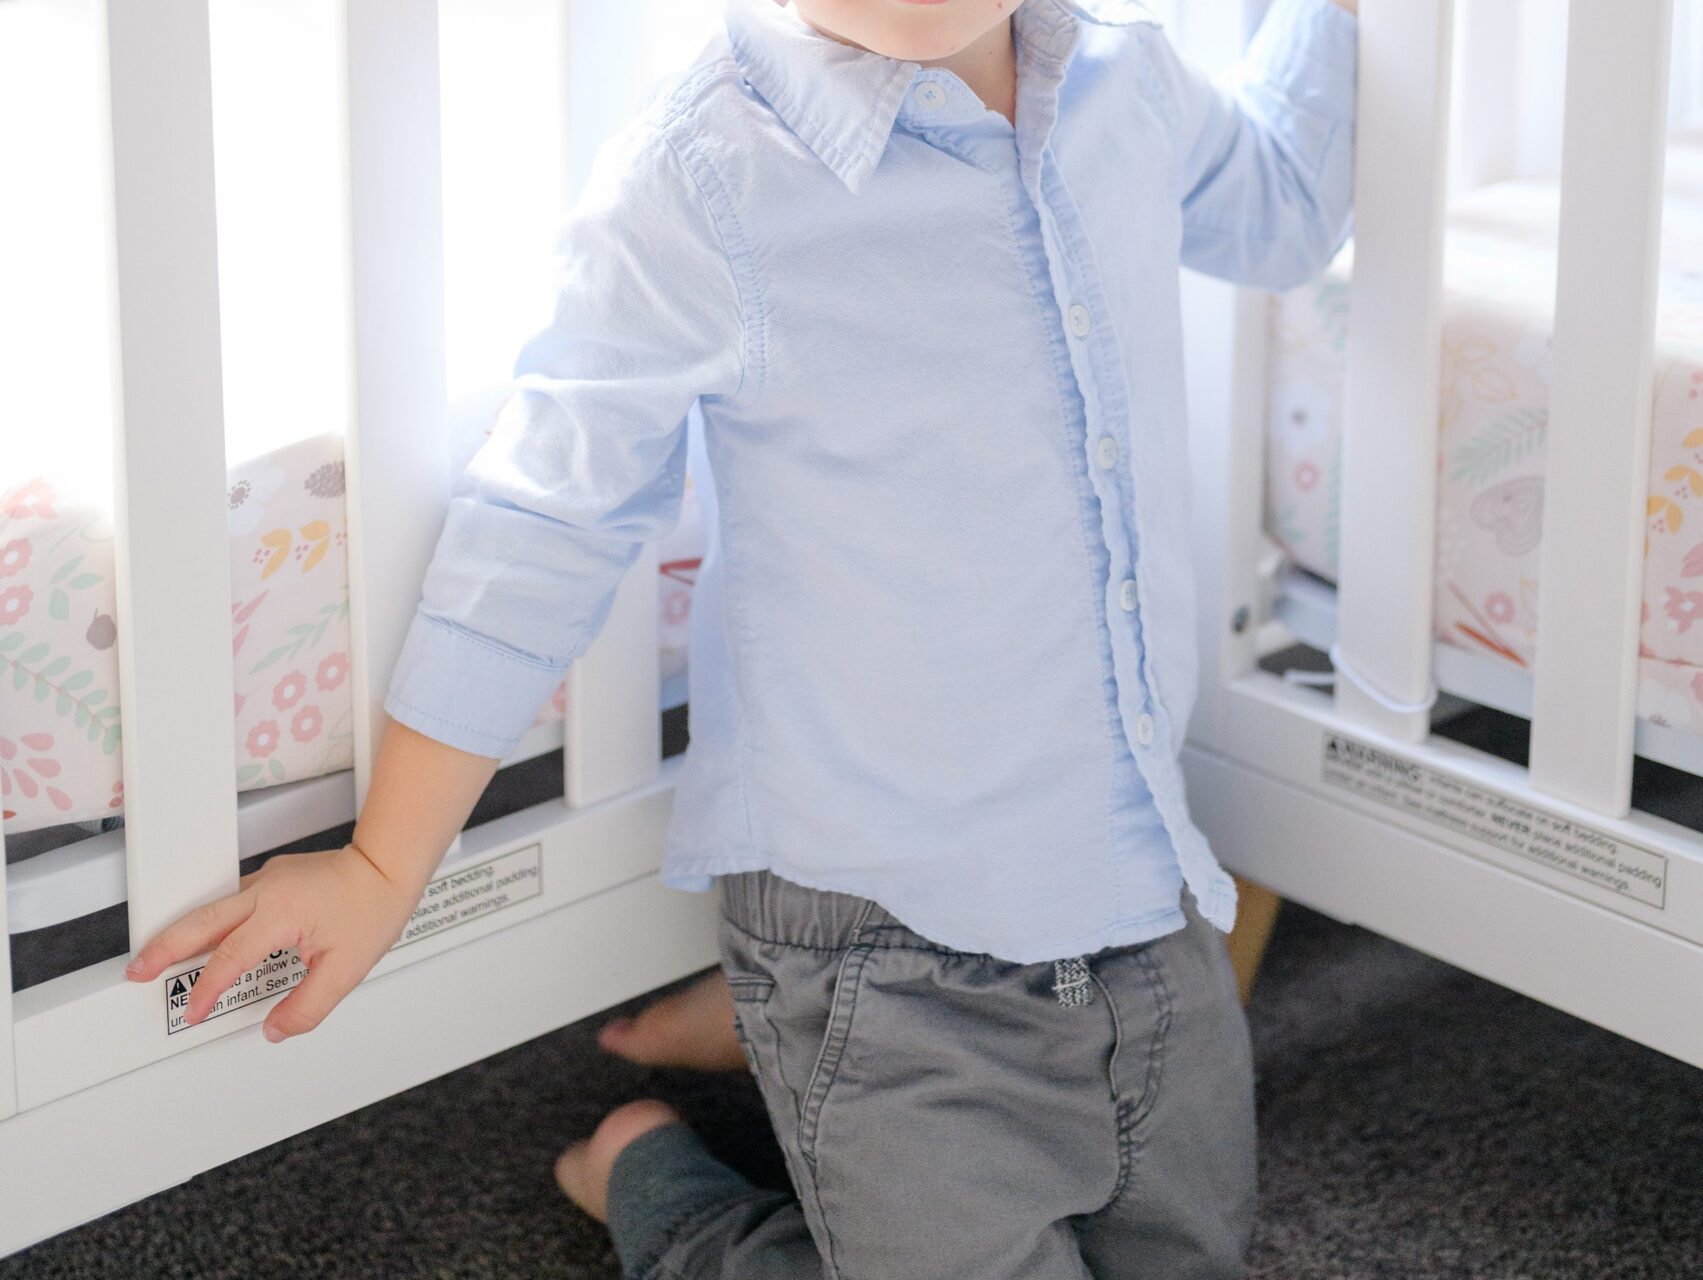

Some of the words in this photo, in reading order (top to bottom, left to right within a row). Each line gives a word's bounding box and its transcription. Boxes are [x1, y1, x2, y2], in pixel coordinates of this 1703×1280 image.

[1552, 820, 1571, 832] soft
[1491, 812, 1530, 834] NEVER
[1565, 842, 1616, 868] additional
[1618, 862, 1662, 889] padding
[1527, 844, 1577, 869] additional
[428, 881, 448, 897] soft
[442, 882, 493, 909] additional
[496, 865, 538, 891] padding
[405, 910, 457, 939] additional
[245, 972, 252, 982] a
[256, 959, 288, 981] pillow
[227, 986, 261, 1007] infant.
[266, 976, 289, 991] See
